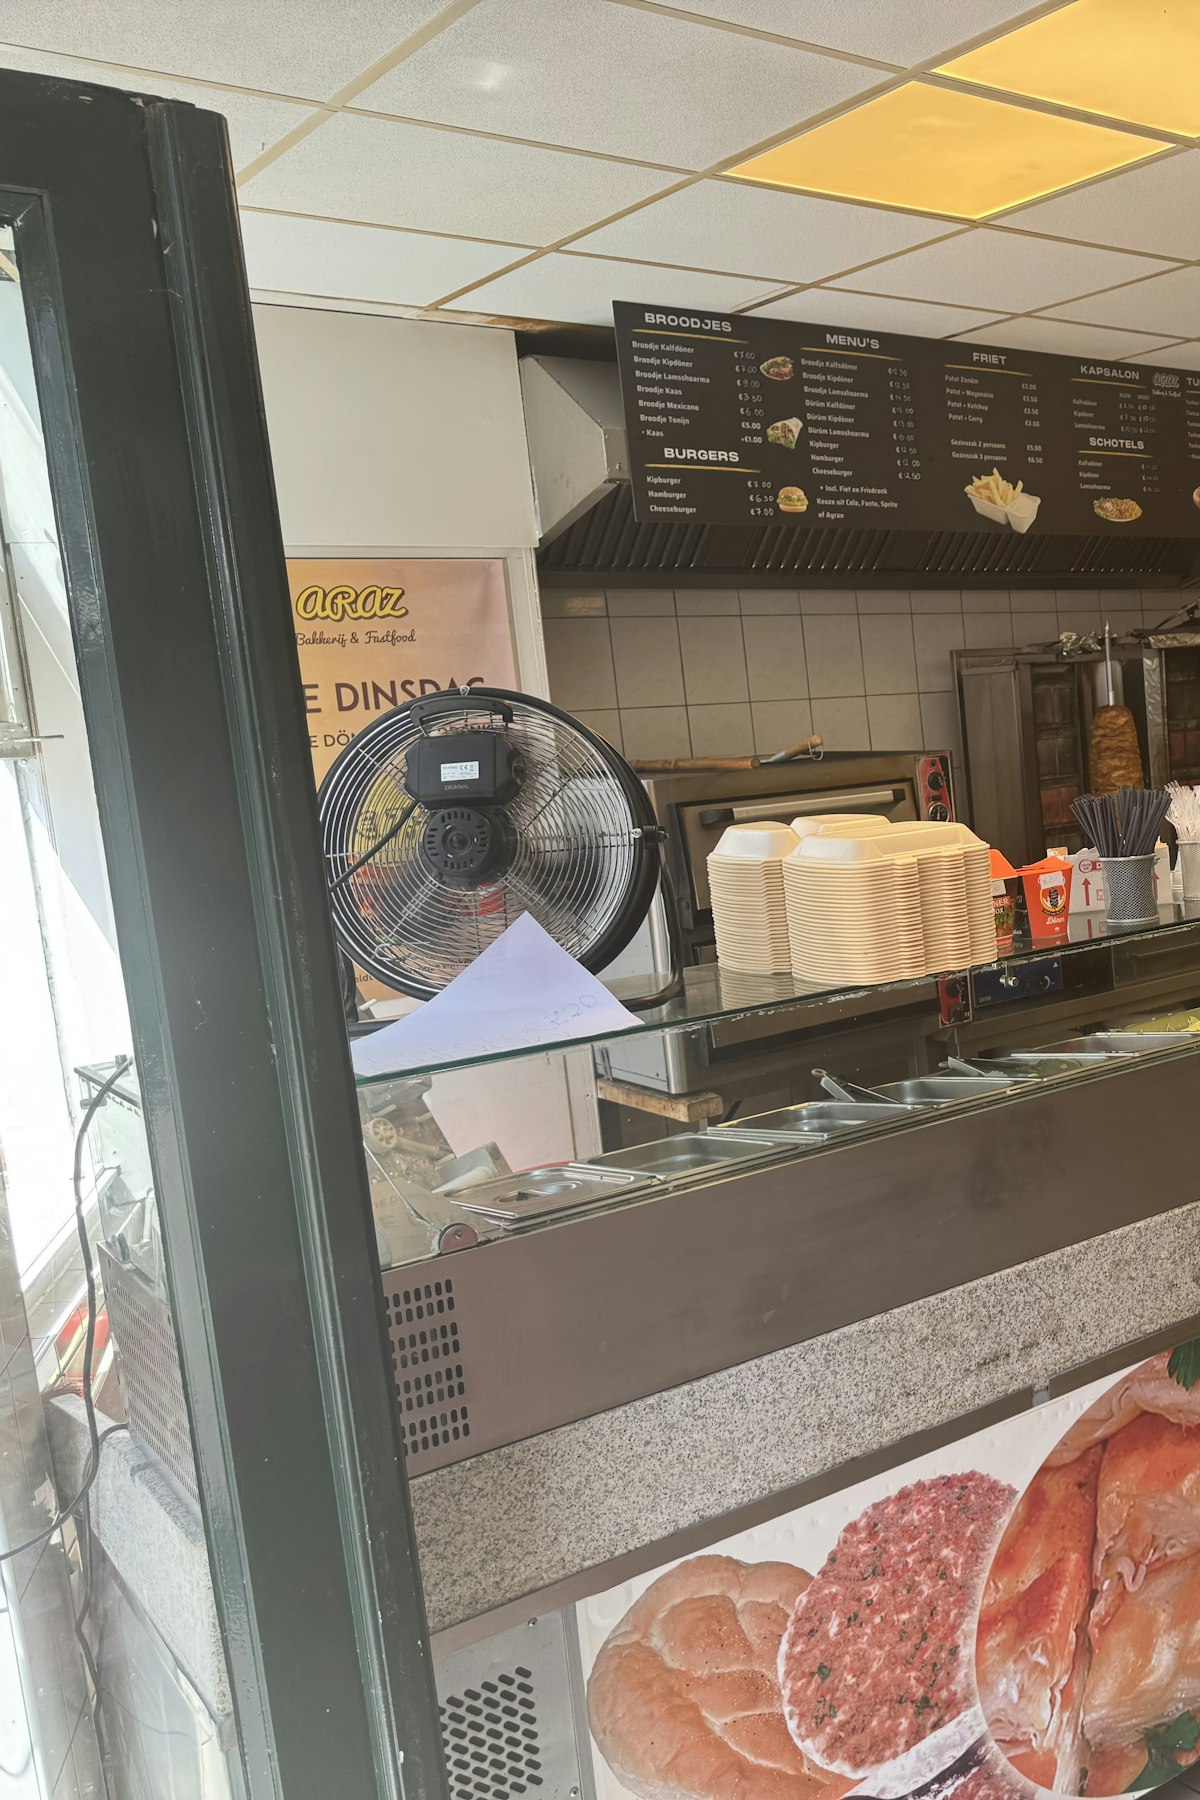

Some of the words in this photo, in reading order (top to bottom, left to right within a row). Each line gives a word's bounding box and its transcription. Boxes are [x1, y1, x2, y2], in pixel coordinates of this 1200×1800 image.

[644, 312, 732, 332] BROODJES
[632, 340, 659, 351] Broodje
[826, 334, 880, 349] MENU'S
[634, 356, 660, 366] Broodje
[662, 358, 693, 368] Kipdöner
[801, 358, 824, 368] Broodje
[972, 352, 1006, 364] FRIET
[636, 370, 662, 380] Broodje
[802, 372, 825, 382] Broodje
[1080, 365, 1139, 380] KAPSALON
[637, 384, 664, 394] Broodje
[665, 387, 682, 395] Kaas
[804, 386, 827, 396] Broodje
[638, 400, 666, 410] Broodje
[666, 402, 699, 411] Mexicano
[805, 399, 825, 407] Dürüm
[640, 414, 667, 424] Broodje
[668, 416, 690, 425] Tonijn
[807, 413, 827, 421] Dürüm
[742, 422, 760, 430] €5.00
[808, 426, 828, 434] Dürüm
[810, 440, 839, 450] Kipburger
[1089, 437, 1144, 450] SCHOTELS
[664, 448, 740, 462] BURGERS
[811, 454, 844, 463] Hamburger
[812, 467, 853, 477] Cheeseburger
[646, 476, 681, 485] Kipburger
[648, 490, 686, 500] Hamburger
[650, 504, 696, 514] Cheeseburger
[296, 632, 348, 647] Bakkerij
[351, 633, 359, 644] &
[365, 630, 416, 645] Fastfood
[992, 898, 1009, 907] NER
